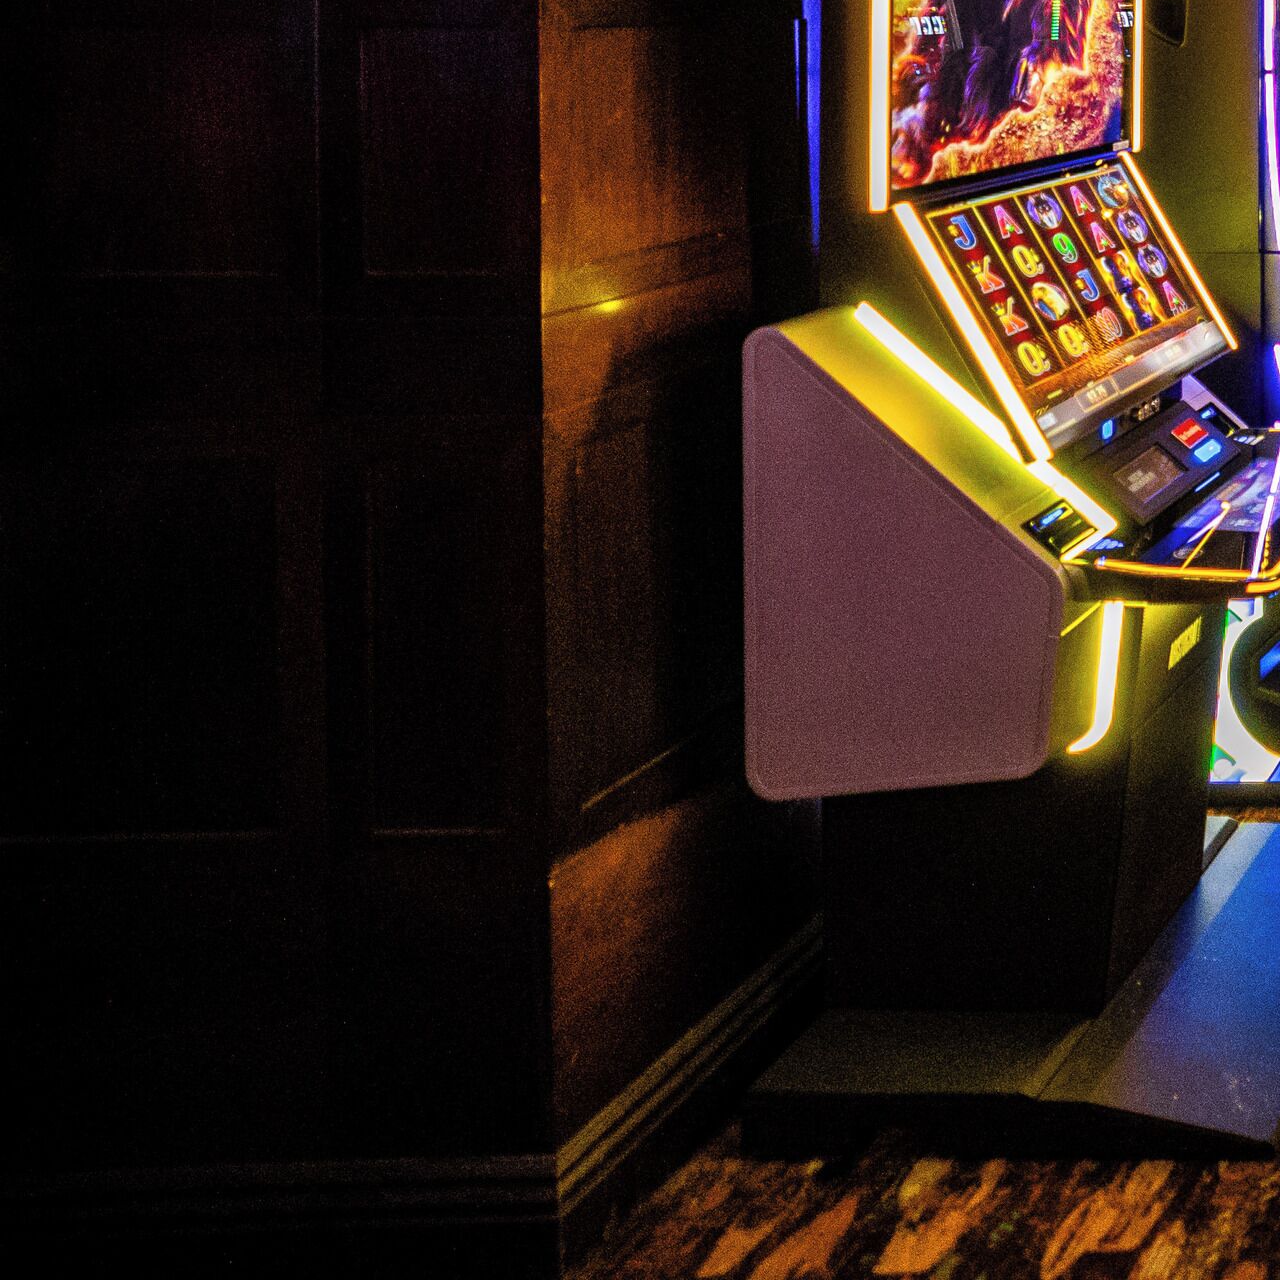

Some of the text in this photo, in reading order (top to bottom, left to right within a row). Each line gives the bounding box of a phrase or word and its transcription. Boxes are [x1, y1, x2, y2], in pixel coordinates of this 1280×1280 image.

[1070, 185, 1096, 217] A
[994, 205, 1023, 239] A
[1090, 222, 1116, 253] A
[1012, 245, 1044, 277] Q
[1052, 233, 1078, 264] 9
[973, 255, 1006, 294] K
[996, 297, 1029, 336] K
[1017, 341, 1050, 376] Q
